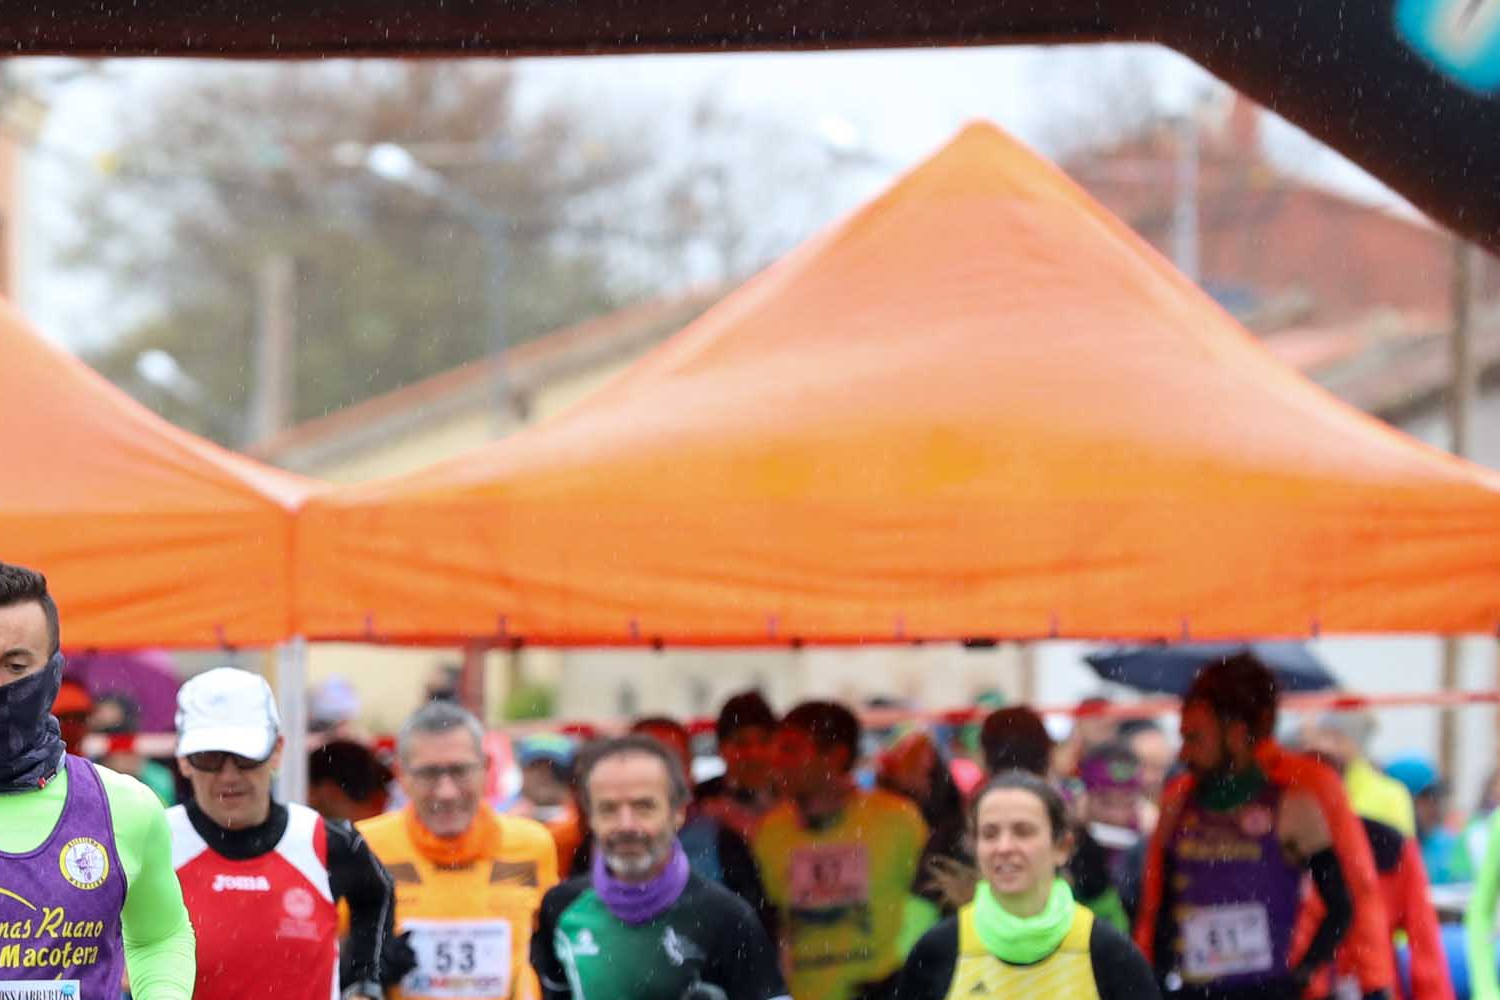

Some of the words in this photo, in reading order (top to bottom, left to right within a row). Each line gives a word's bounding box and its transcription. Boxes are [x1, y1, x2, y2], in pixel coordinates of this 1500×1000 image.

[35, 907, 103, 938] Ruano
[0, 941, 98, 968] Macotera
[436, 941, 475, 973] 53
